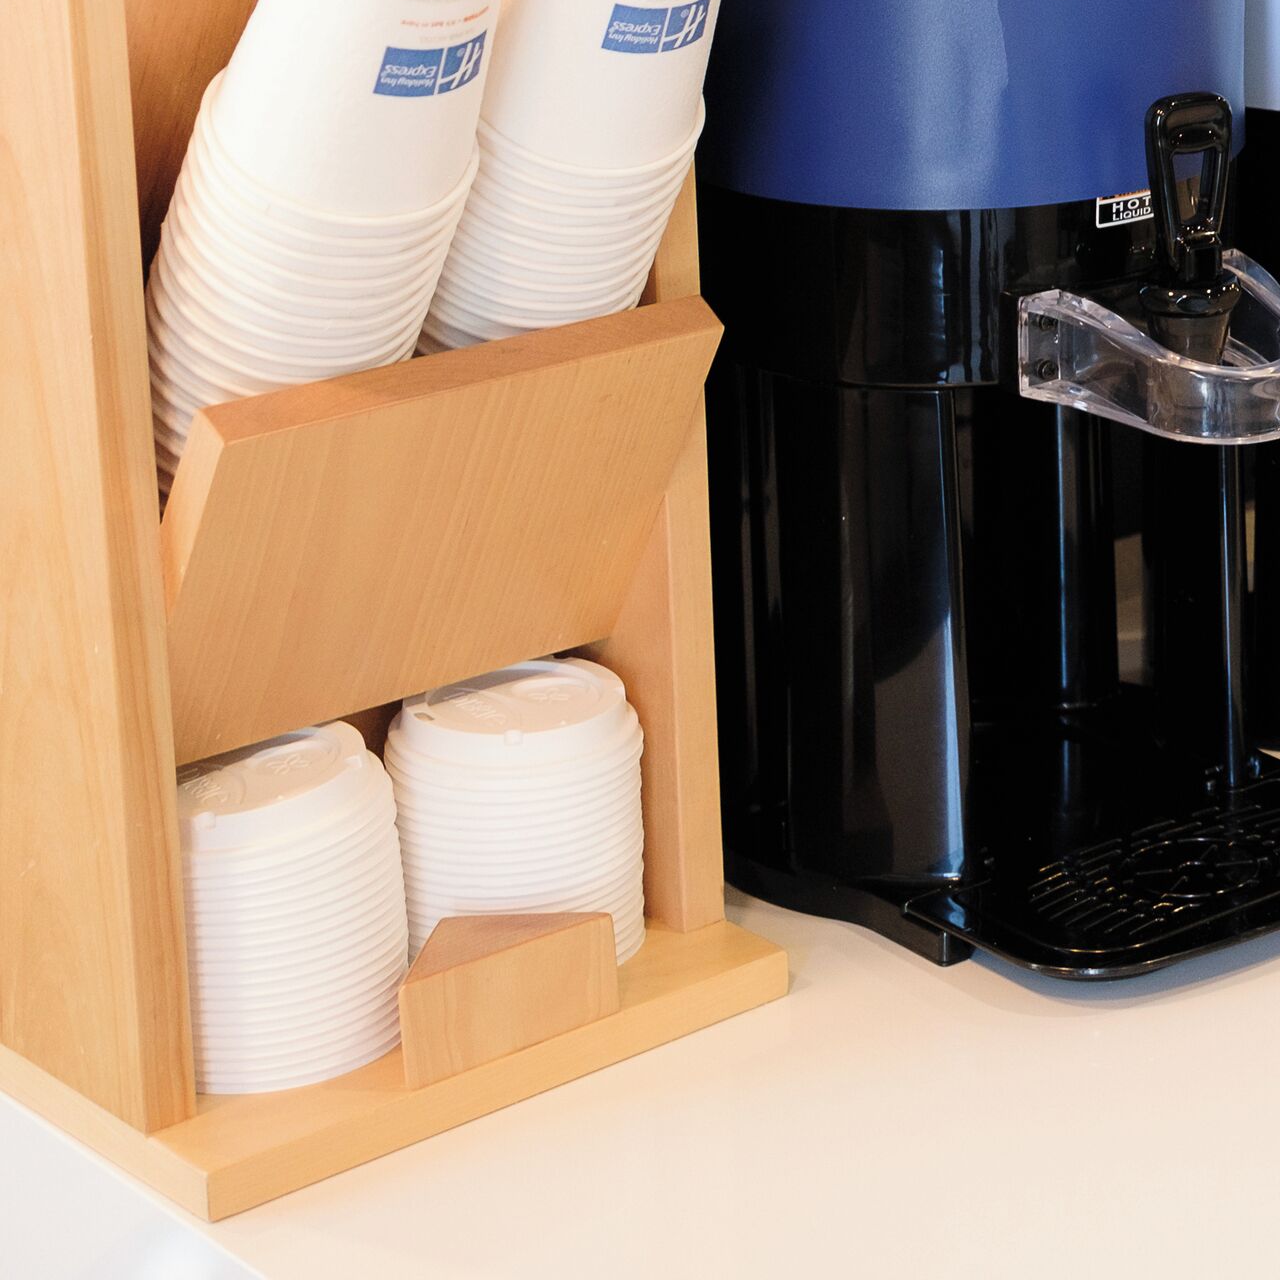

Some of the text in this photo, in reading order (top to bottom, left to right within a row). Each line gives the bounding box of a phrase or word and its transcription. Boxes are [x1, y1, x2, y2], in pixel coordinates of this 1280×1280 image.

[611, 20, 662, 36] Express
[607, 32, 659, 46] Holiday Inn
[384, 64, 438, 78] Express
[396, 76, 435, 88] Holiday
[1112, 195, 1152, 213] HOT
[1112, 206, 1152, 222] LIQUID
